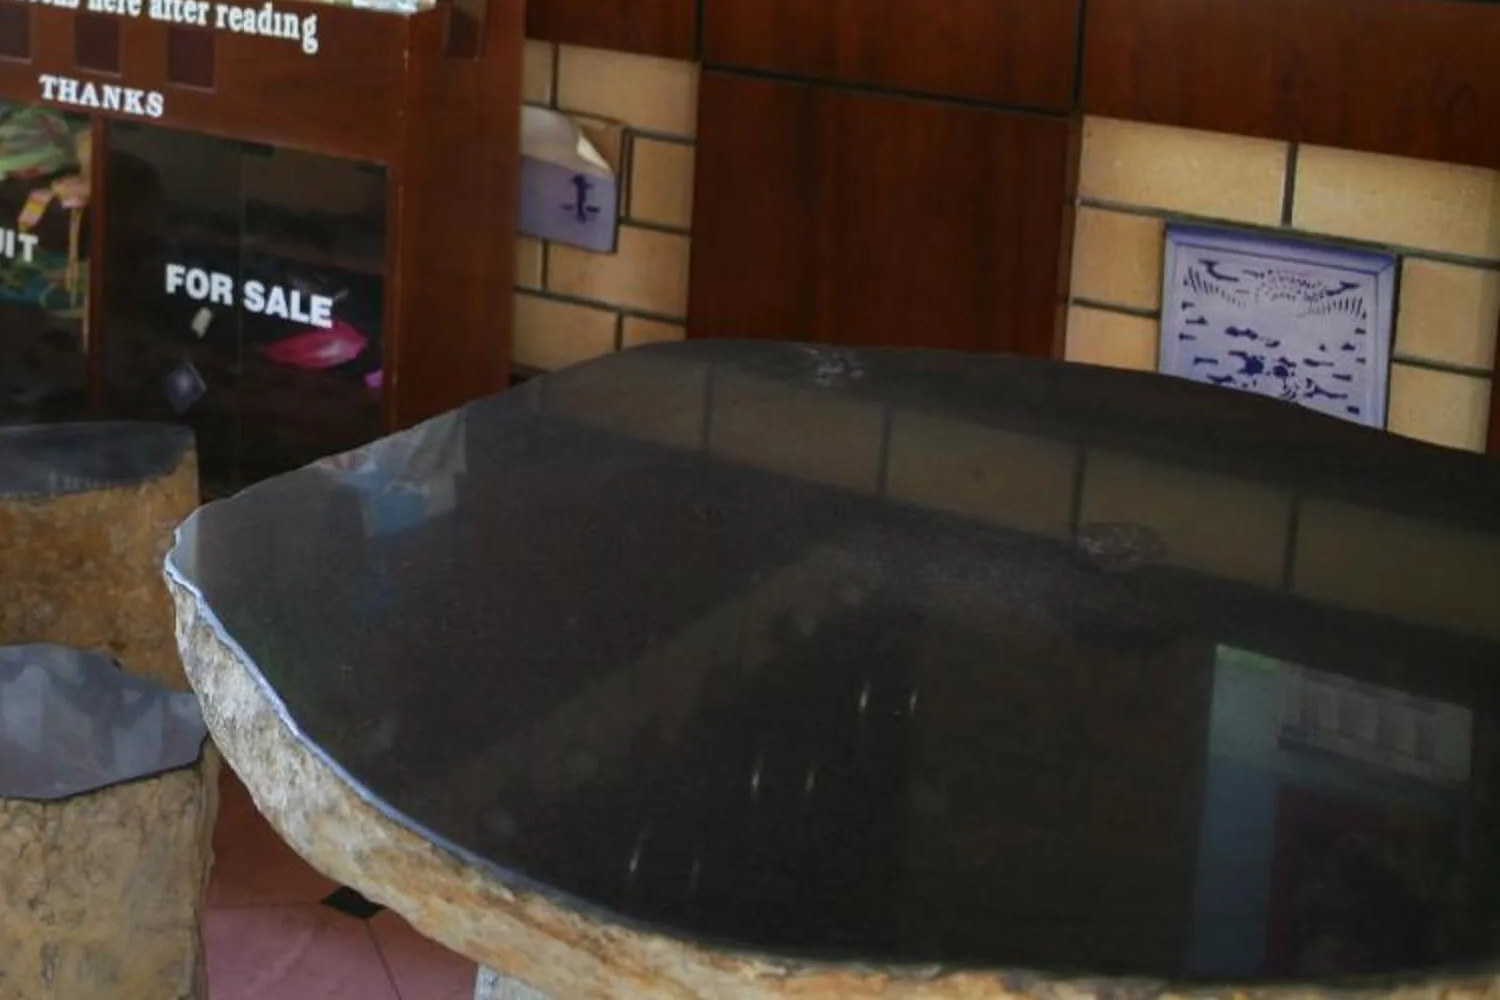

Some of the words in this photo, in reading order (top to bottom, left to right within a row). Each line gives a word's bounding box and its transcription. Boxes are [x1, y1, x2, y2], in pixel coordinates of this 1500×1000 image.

[216, 1, 319, 55] reading
[39, 74, 165, 118] THANKS
[165, 263, 234, 306] FOR
[243, 280, 334, 329] SALE
